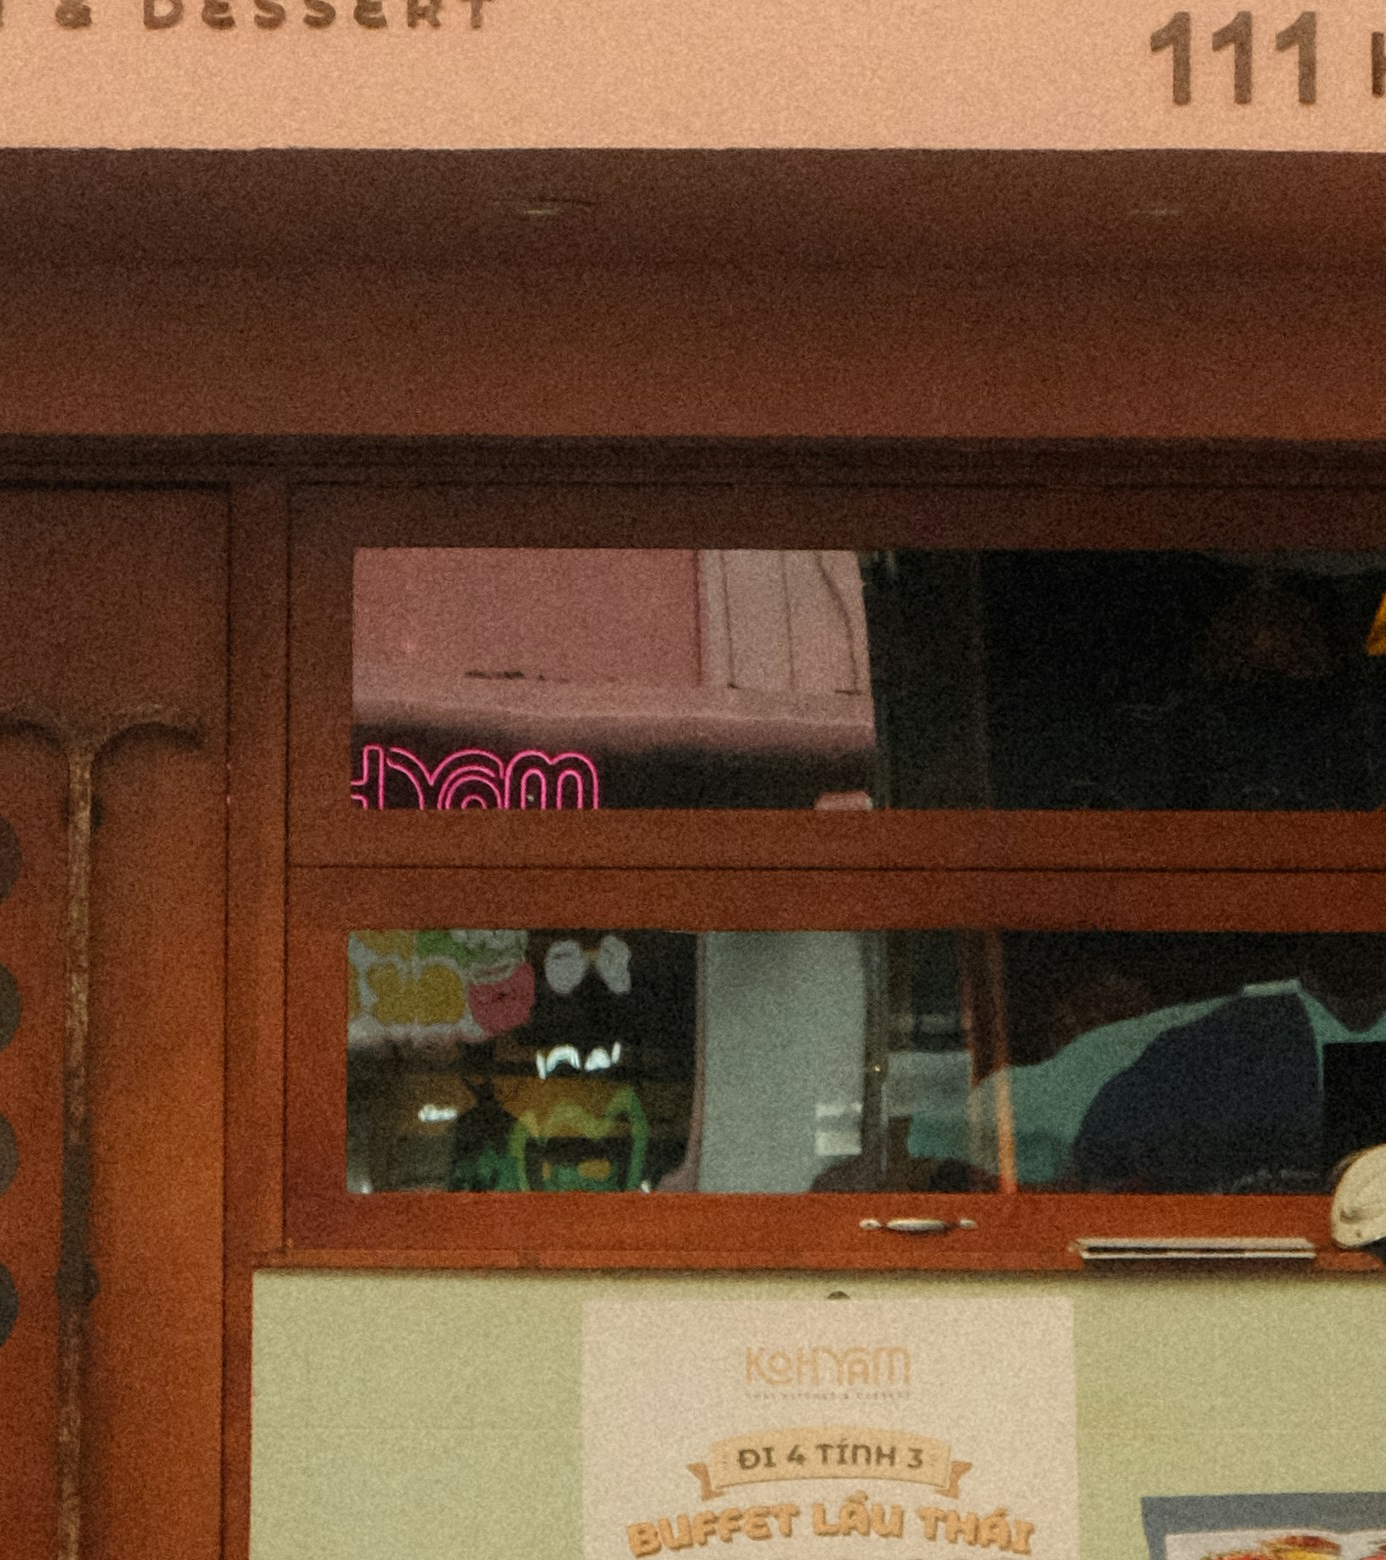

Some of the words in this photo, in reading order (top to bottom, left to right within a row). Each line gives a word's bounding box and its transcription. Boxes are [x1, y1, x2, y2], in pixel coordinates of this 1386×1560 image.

[1149, 11, 1320, 106] 111
[737, 1444, 777, 1471] ĐI
[788, 1444, 806, 1467] 4
[907, 1447, 924, 1469] 3
[626, 1501, 803, 1559] BUFFET
[916, 1506, 1036, 1556] THÁI
